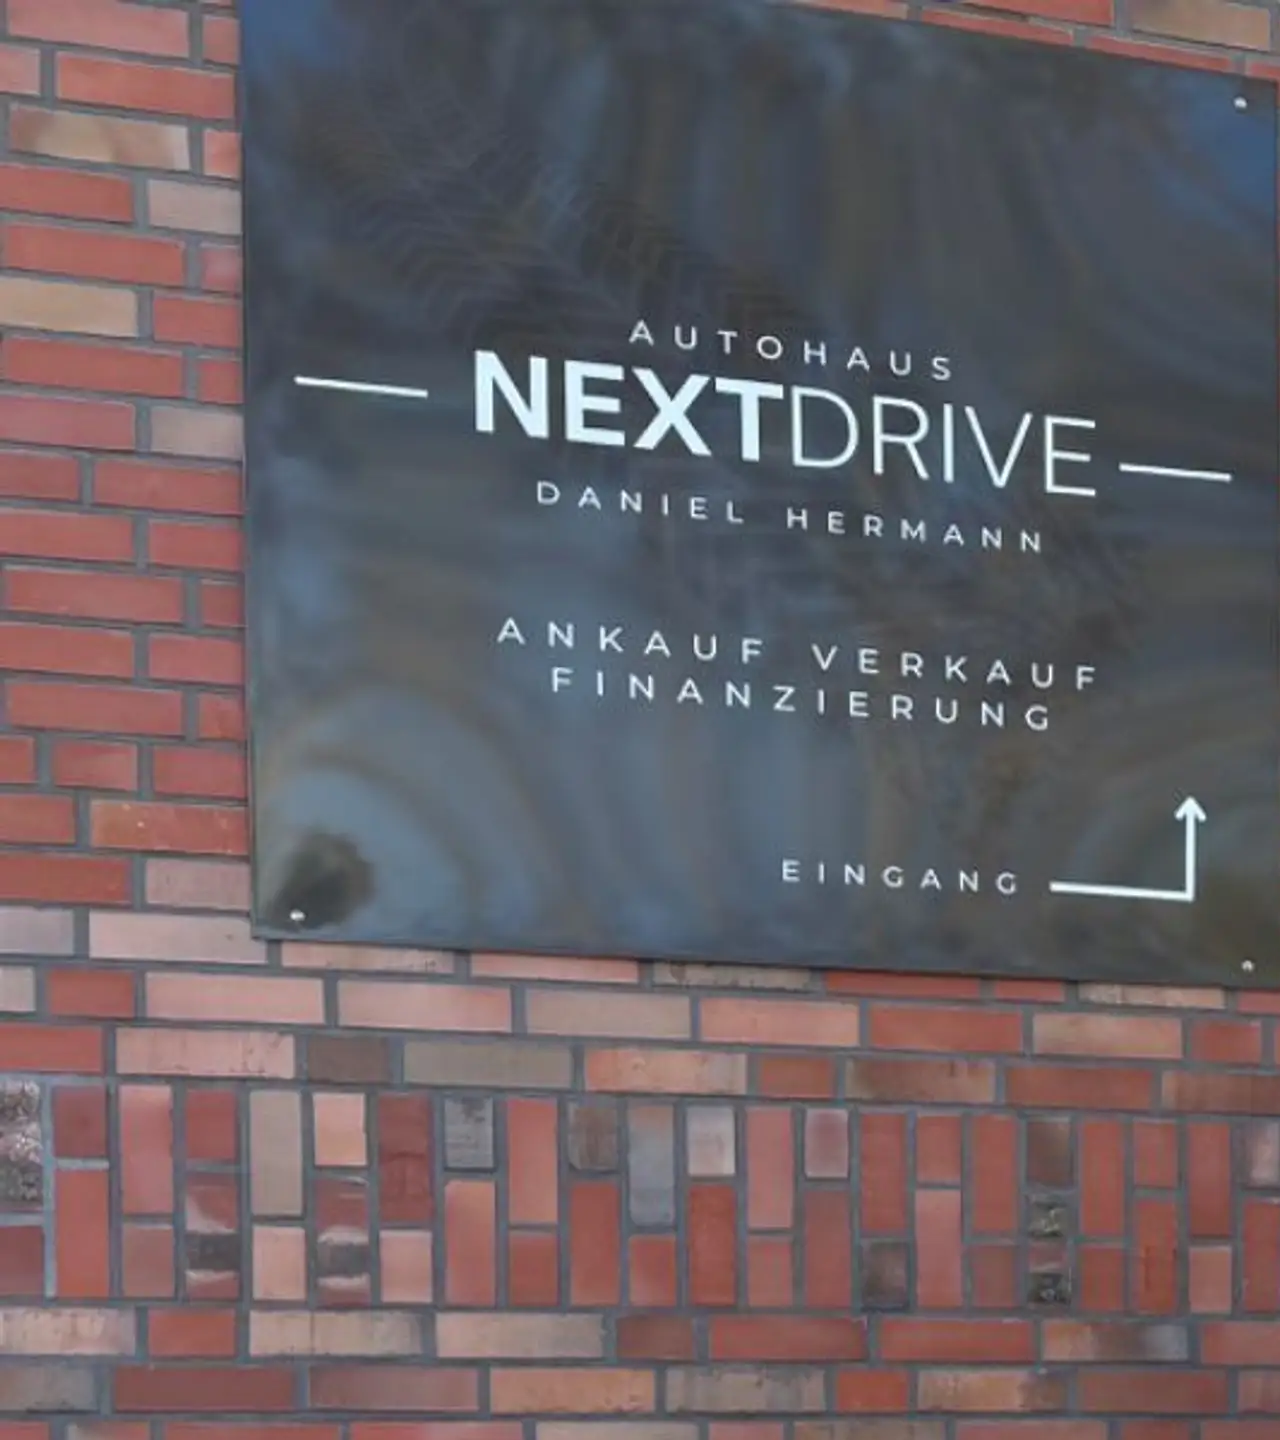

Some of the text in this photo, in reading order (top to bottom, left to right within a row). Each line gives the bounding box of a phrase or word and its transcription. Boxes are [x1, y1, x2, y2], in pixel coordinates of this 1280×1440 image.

[629, 319, 951, 381] AUTOHAUS
[474, 349, 1097, 497] NEXTDRIVE
[536, 481, 1041, 553] DANIEL HERMANN
[497, 617, 1096, 691] ANKAUF VERKAUF
[551, 666, 1049, 731] FINANZIERUNG
[782, 859, 1017, 895] EINGANG
